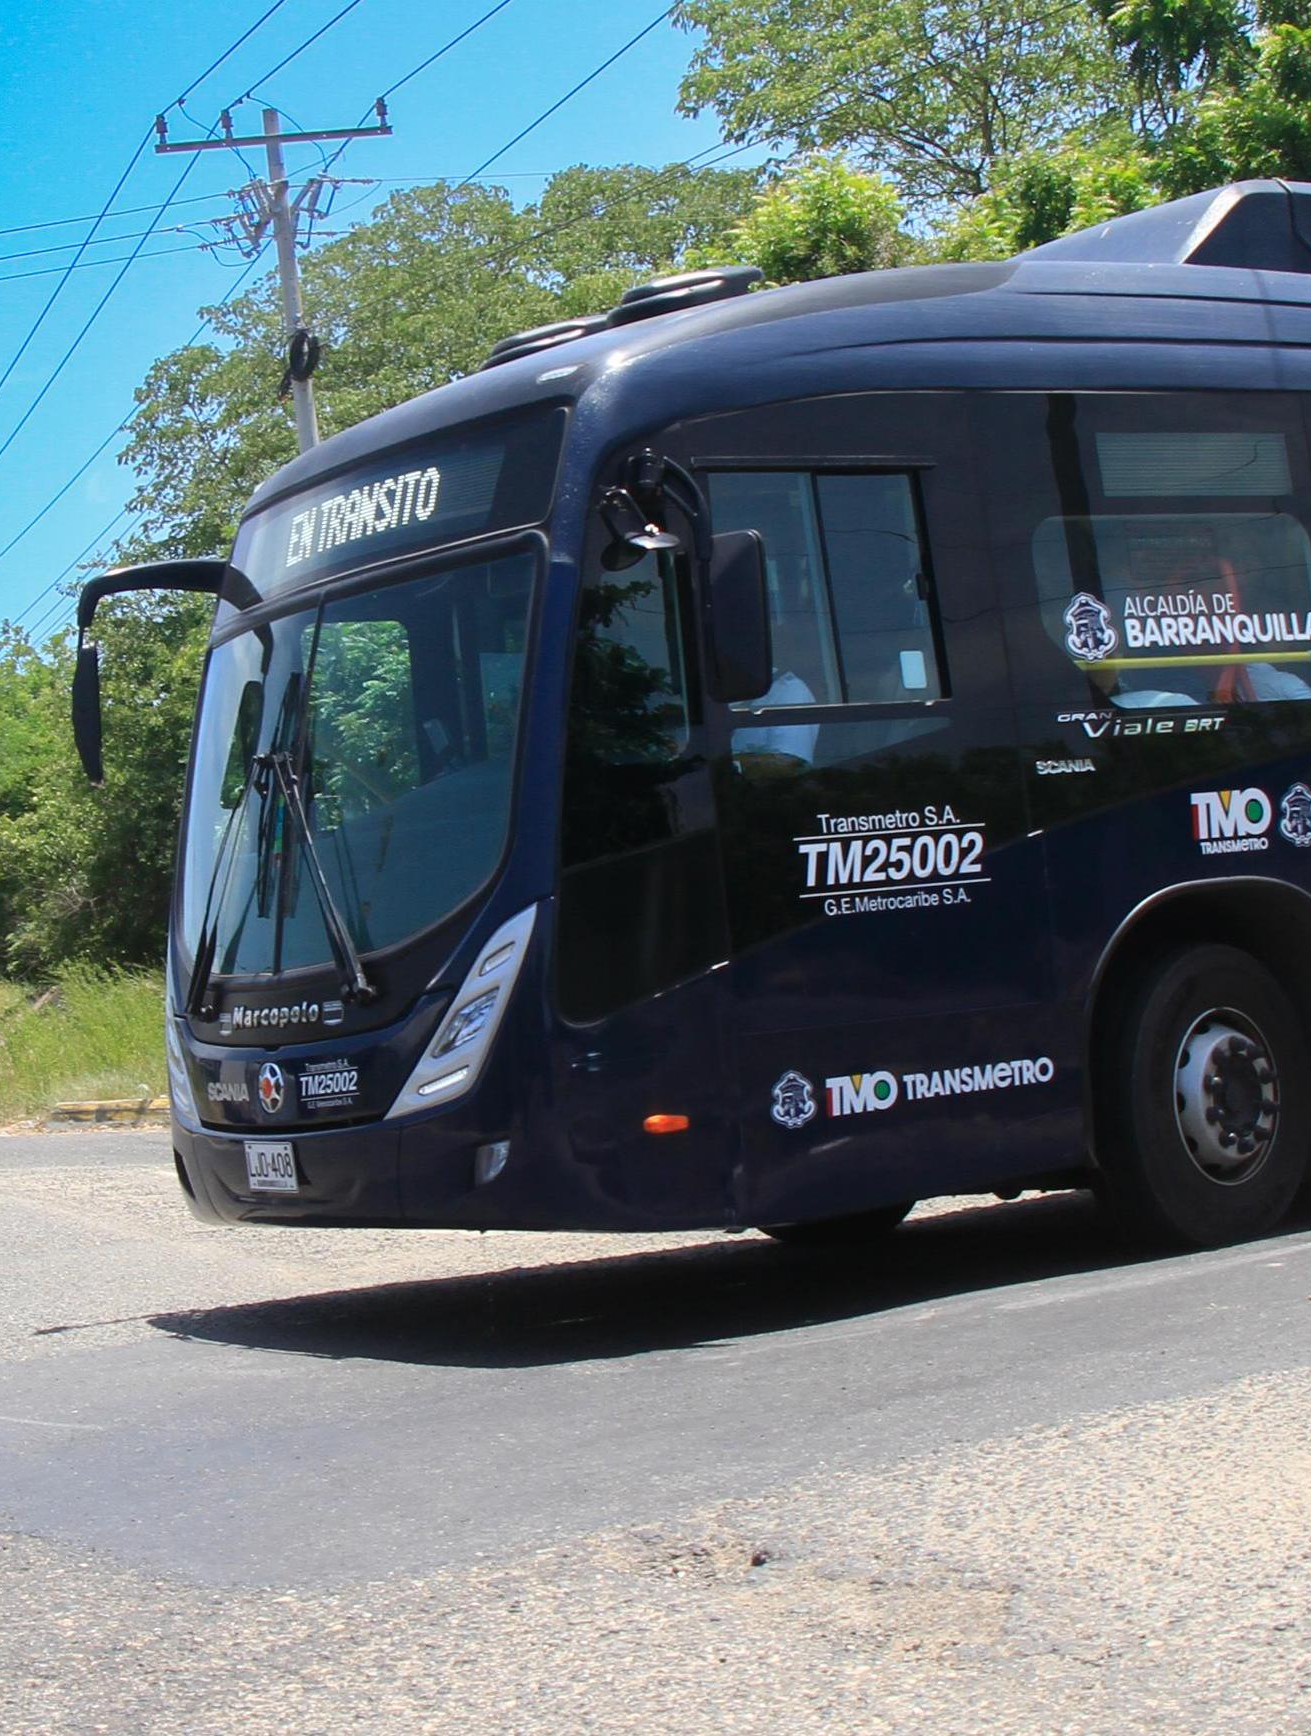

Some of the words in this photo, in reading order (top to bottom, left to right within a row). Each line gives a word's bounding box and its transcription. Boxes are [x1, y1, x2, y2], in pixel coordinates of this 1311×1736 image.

[285, 507, 316, 567] EN
[316, 466, 442, 553] TRANSITO
[1124, 590, 1207, 617] ALCALDÍA
[1212, 593, 1236, 614] DE
[1057, 713, 1112, 723] GRAN
[1083, 718, 1175, 738] Viale
[1184, 717, 1225, 732] BRT
[1035, 758, 1096, 775] SCANIA
[817, 811, 919, 834] Transmetro
[924, 805, 960, 825] S.A.
[1191, 788, 1272, 840] TMO
[799, 831, 984, 887] TM25002
[943, 887, 971, 905] S.A.
[232, 1001, 319, 1029] Marcopolo
[208, 1082, 250, 1101] SCANIA
[300, 1071, 358, 1096] TM25002
[826, 1071, 898, 1117] TMO
